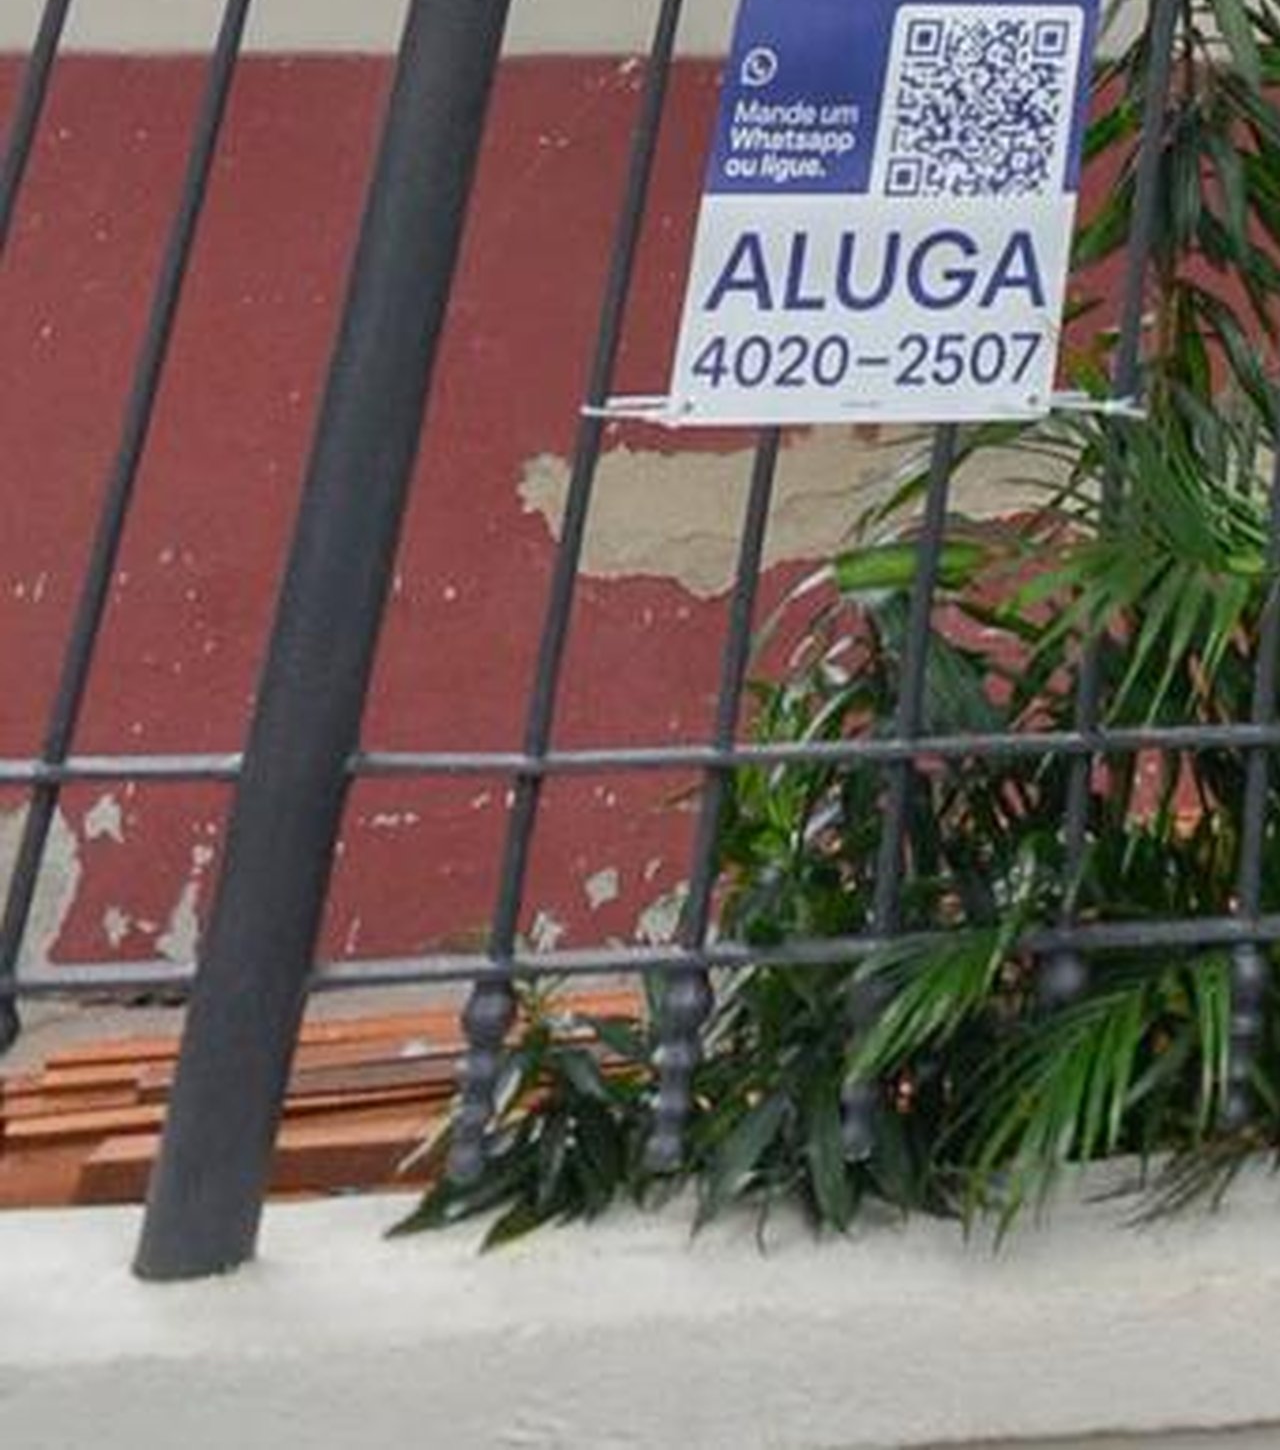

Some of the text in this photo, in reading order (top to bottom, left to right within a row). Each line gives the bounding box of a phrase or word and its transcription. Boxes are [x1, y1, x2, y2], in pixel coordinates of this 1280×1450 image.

[734, 99, 860, 126] Mande um
[729, 127, 856, 157] Whatsapp
[724, 151, 826, 183] ou ligue.
[704, 229, 1046, 311] ALUGA
[691, 332, 1042, 388] 4020-2507
